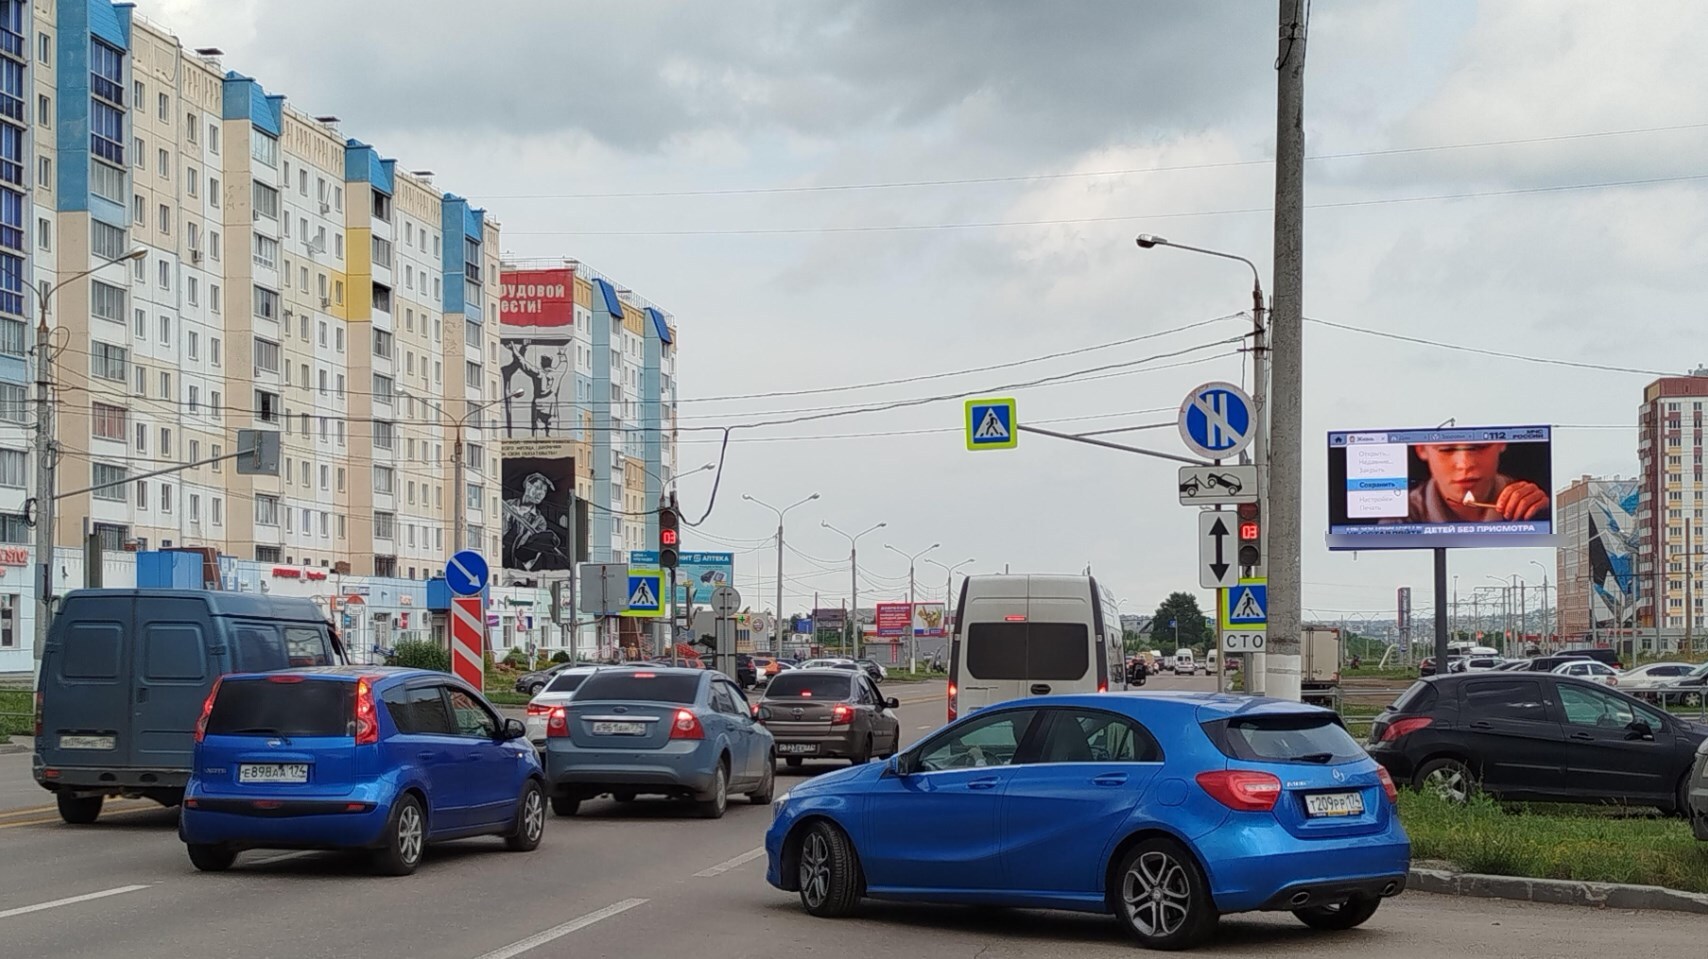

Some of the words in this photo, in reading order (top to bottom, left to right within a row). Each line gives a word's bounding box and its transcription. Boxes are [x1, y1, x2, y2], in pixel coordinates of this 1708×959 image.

[1489, 431, 1506, 440] 112
[1359, 481, 1396, 489] Сохранить
[1242, 526, 1258, 539] 03
[1424, 525, 1456, 535] ДЕТЕЙ
[1457, 525, 1475, 534] БЕЗ
[1476, 524, 1536, 533] ПРИСМОТРА
[663, 531, 676, 544] 03
[1226, 635, 1264, 648] СТО
